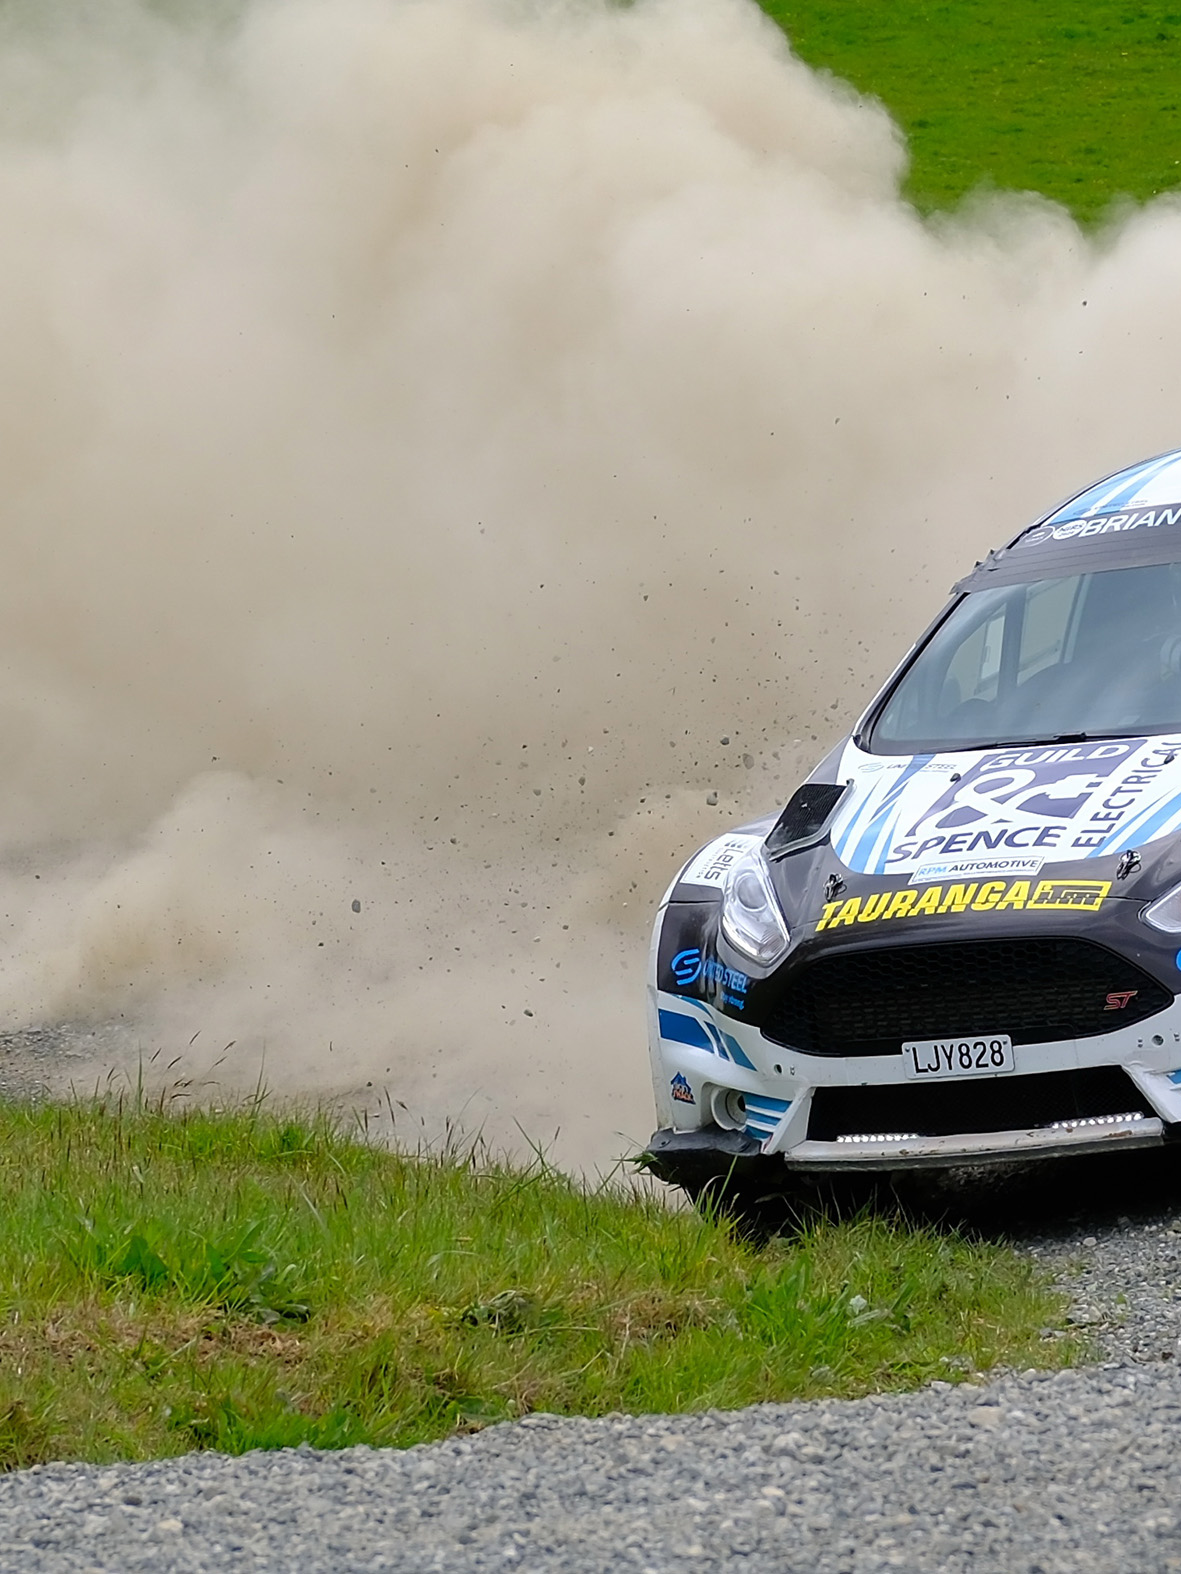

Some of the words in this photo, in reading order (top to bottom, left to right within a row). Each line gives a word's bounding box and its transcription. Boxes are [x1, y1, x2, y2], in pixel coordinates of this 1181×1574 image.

[980, 743, 1131, 772] GUILD
[885, 825, 1068, 864] SPENCE
[704, 848, 744, 881] Letts
[918, 865, 948, 876] RPM
[948, 859, 1040, 873] AUTOMOTIVE
[815, 880, 1031, 932] TAURANGA
[724, 968, 747, 994] STEEL
[1103, 990, 1138, 1010] ST
[911, 1040, 1005, 1074] LJY828
